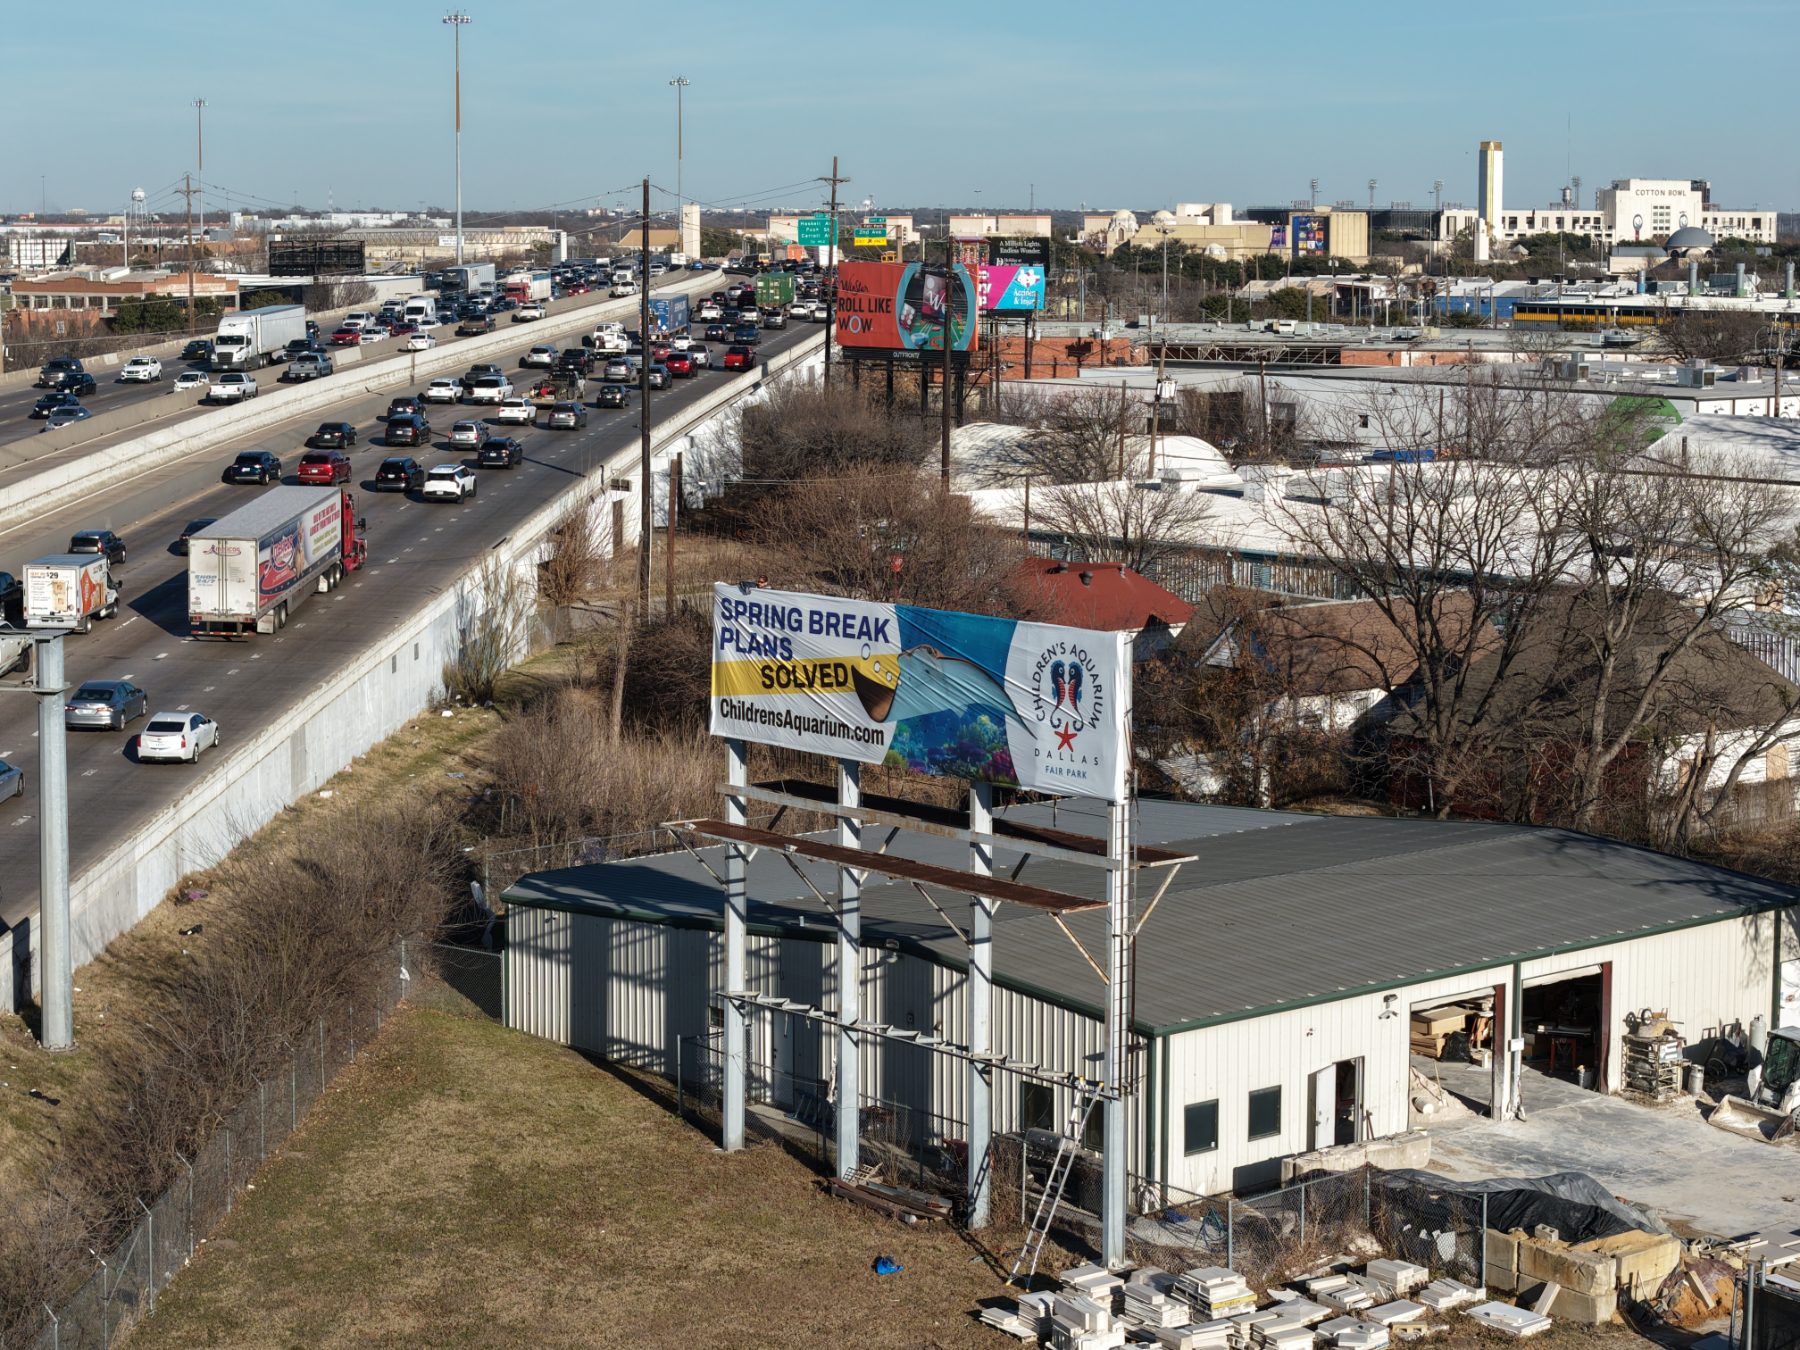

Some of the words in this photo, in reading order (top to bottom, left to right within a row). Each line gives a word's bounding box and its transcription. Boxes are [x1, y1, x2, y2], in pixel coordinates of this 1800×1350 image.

[838, 297, 865, 313] ROLL
[868, 297, 892, 313] LIKE
[46, 571, 59, 579] $29
[720, 598, 803, 633] SPRING
[809, 610, 890, 644] BREAK
[720, 627, 793, 662] PLANS
[761, 663, 849, 689] SOLVED
[1032, 641, 1067, 722] CHILDREN'S
[1069, 643, 1104, 731] AQUARIUM
[720, 699, 885, 746] ChildrensAquarium.com
[1034, 748, 1100, 766] DALLAS
[1045, 765, 1064, 776] FAIR
[1066, 766, 1088, 780] PARK
